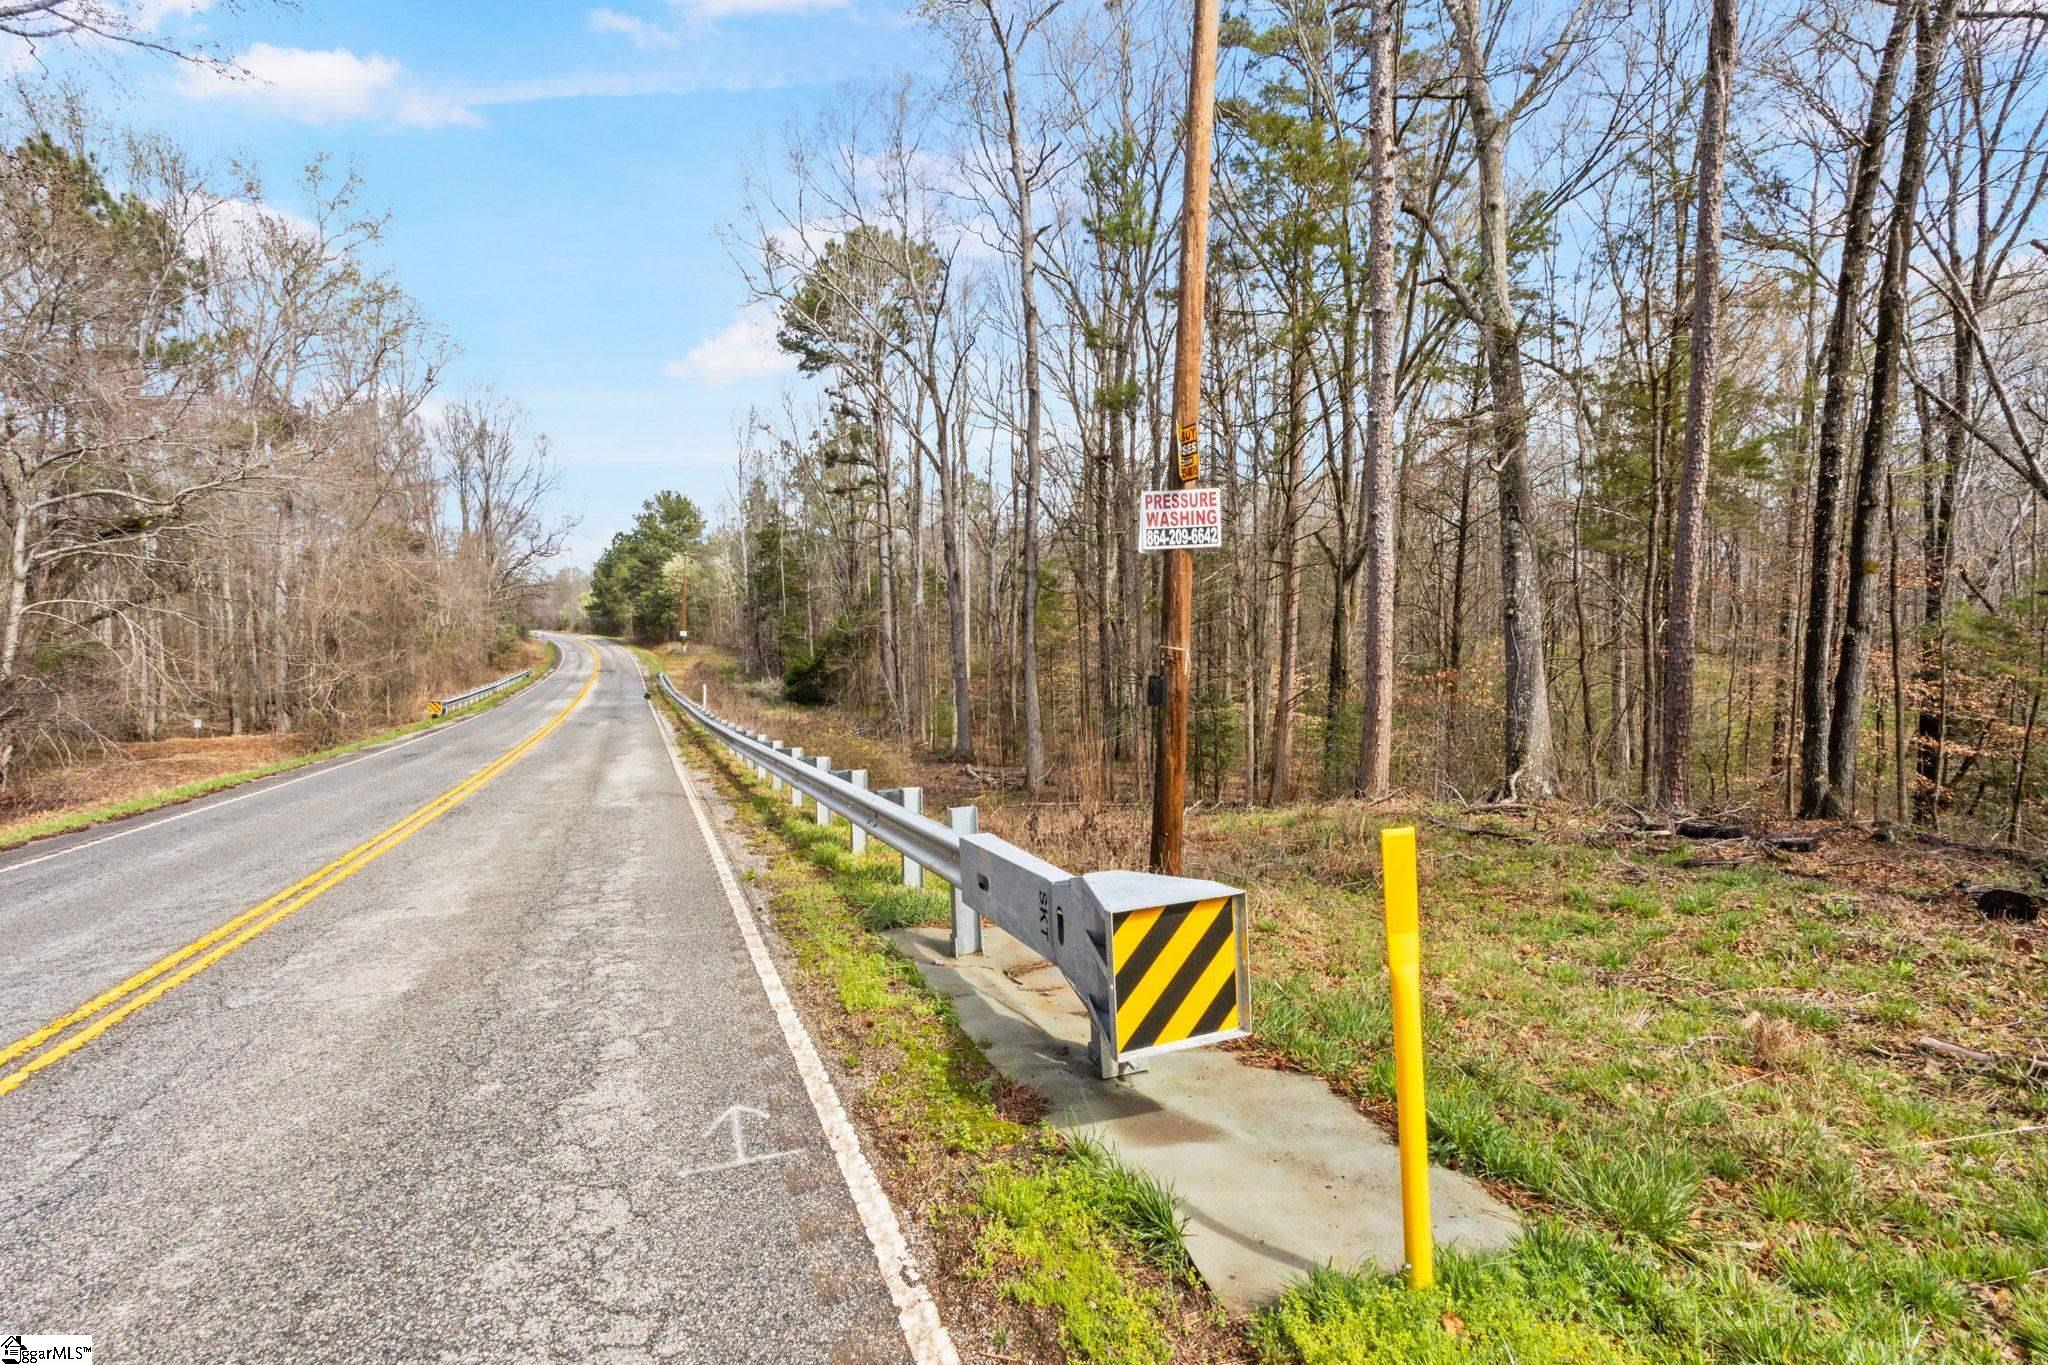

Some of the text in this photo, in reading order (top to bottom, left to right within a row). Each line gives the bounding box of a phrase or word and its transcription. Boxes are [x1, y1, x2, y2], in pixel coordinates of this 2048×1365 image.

[1181, 442, 1197, 456] SES
[1145, 492, 1217, 510] PRESSURE
[1146, 510, 1217, 527] WASHING
[1146, 528, 1218, 546] 864-209-6642
[1039, 891, 1049, 942] SKT
